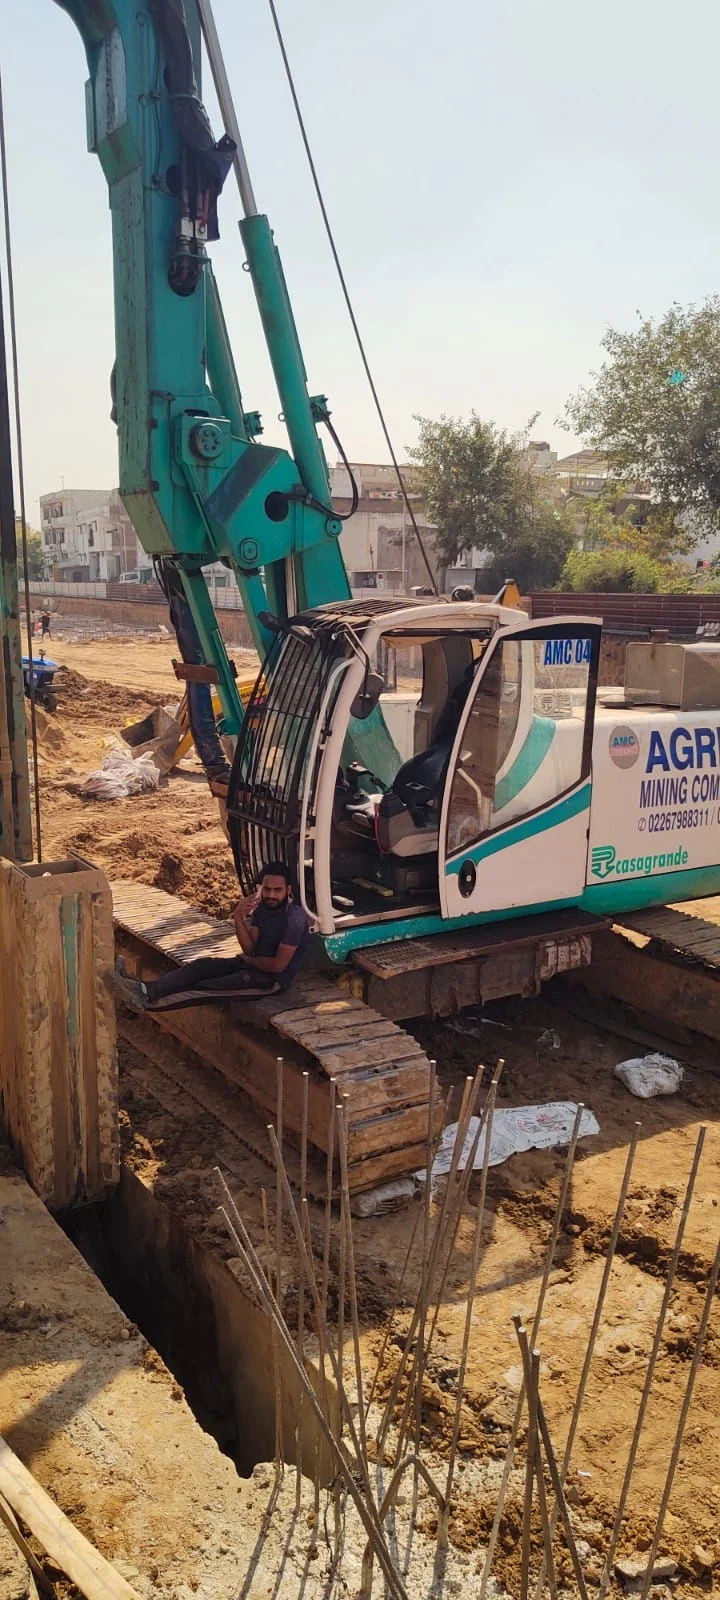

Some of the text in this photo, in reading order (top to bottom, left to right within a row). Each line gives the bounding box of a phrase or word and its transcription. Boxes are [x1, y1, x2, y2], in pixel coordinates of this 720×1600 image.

[544, 639, 592, 665] AMC 04
[612, 735, 635, 746] AMC
[639, 774, 720, 809] MINING COM
[648, 808, 709, 833] 02267988311
[615, 845, 688, 874] casagrande
